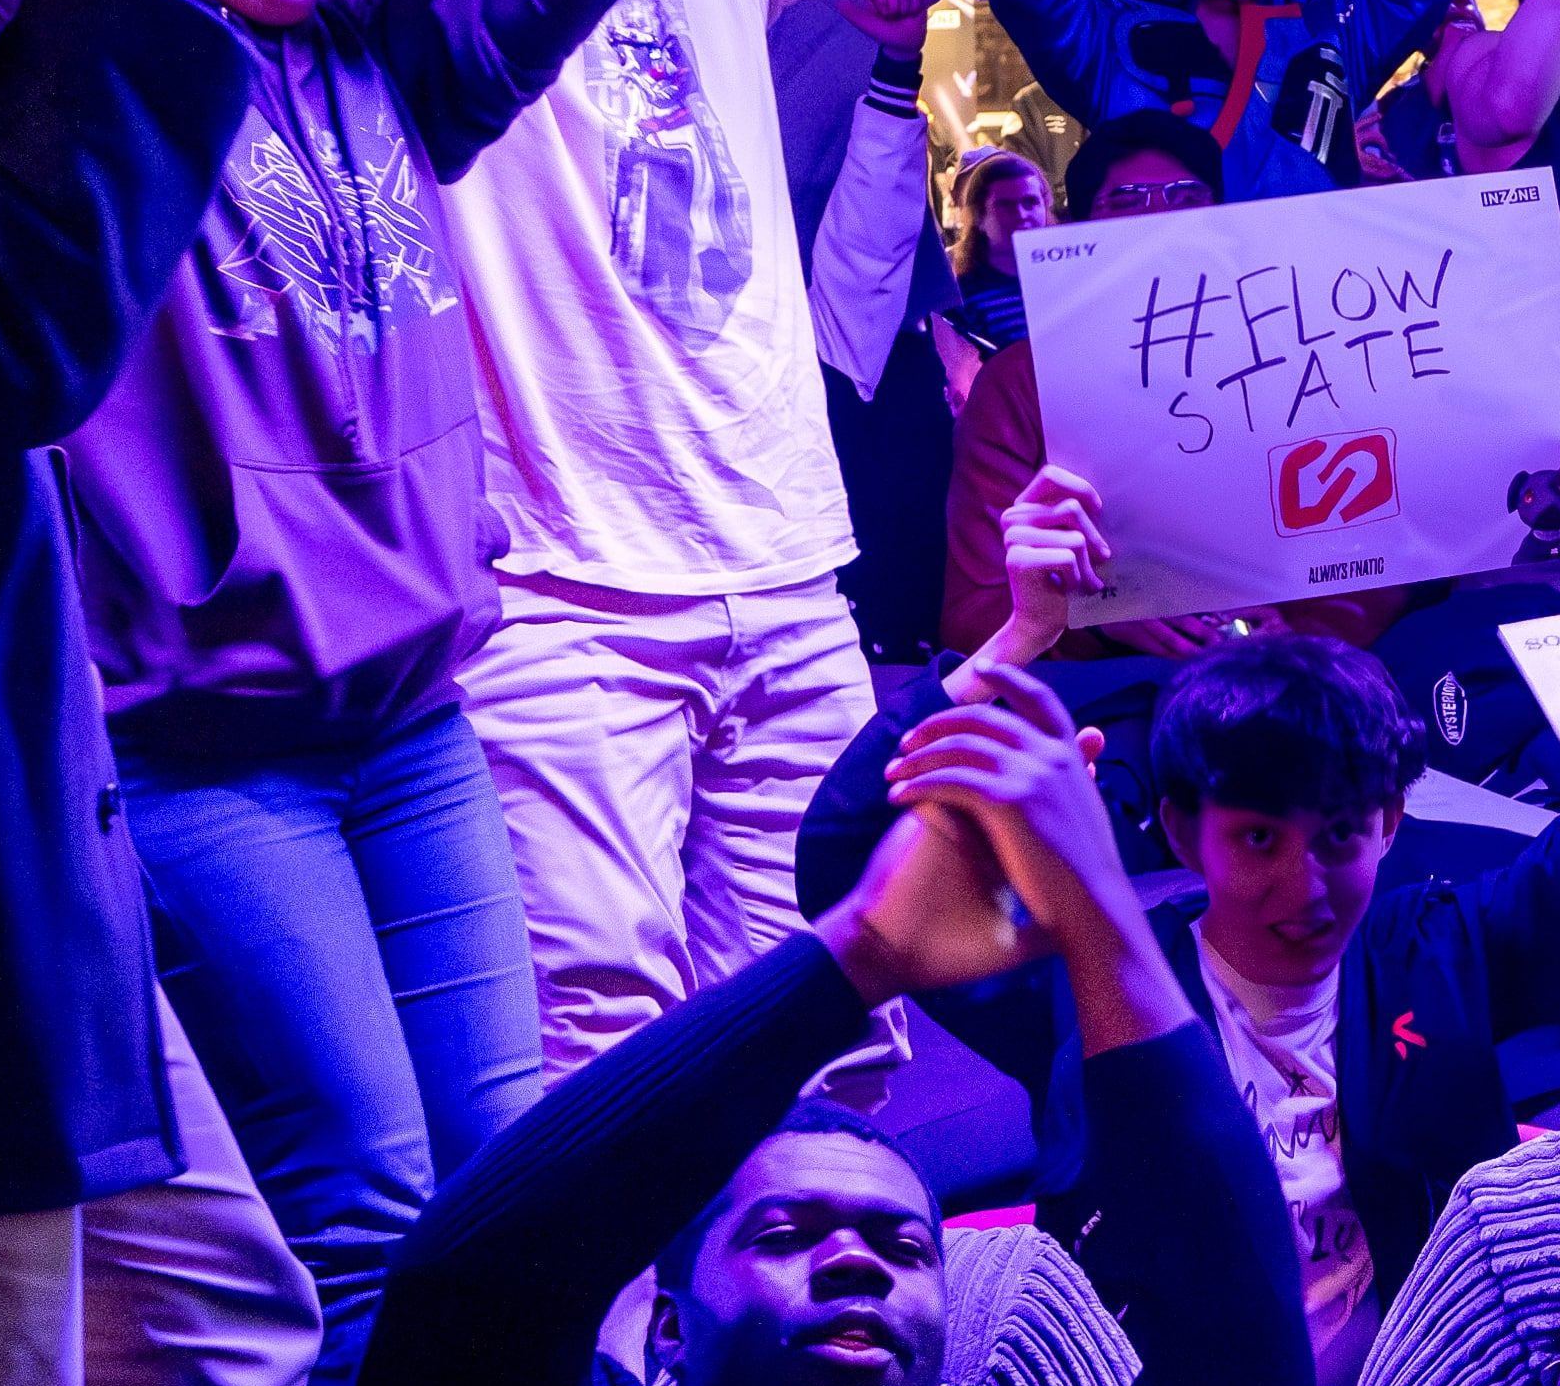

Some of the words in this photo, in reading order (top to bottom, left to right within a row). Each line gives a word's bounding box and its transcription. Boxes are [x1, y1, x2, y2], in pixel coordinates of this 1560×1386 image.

[1481, 186, 1540, 207] INZONE
[1030, 242, 1098, 264] SONY
[1129, 248, 1453, 388] #FLOW
[1168, 319, 1451, 454] STATE
[1308, 562, 1348, 585] ALWAYS
[1350, 556, 1385, 578] FNATIC
